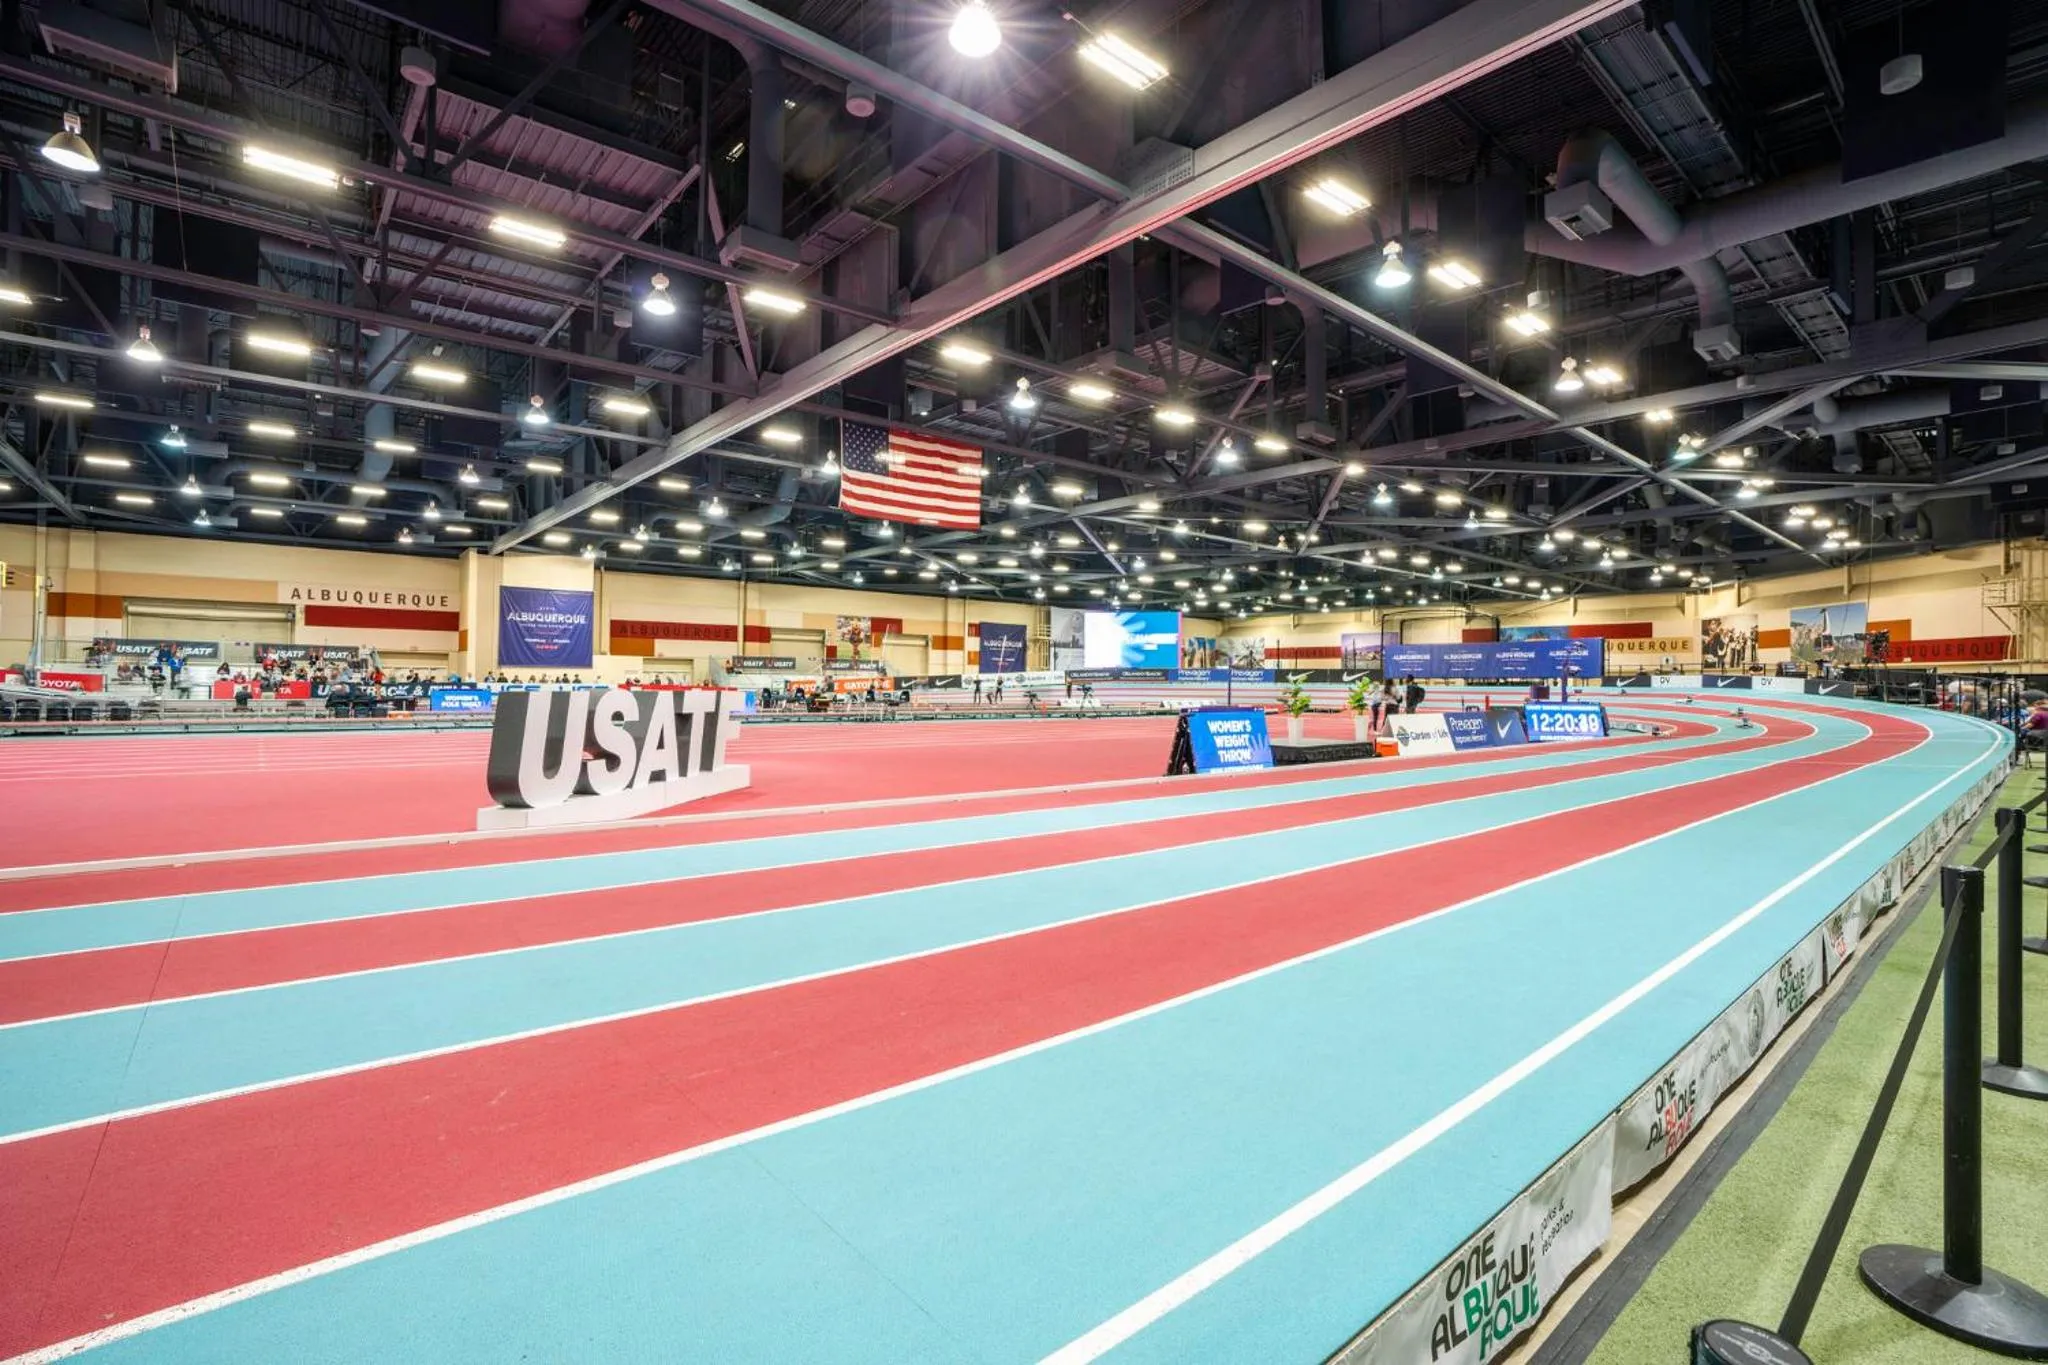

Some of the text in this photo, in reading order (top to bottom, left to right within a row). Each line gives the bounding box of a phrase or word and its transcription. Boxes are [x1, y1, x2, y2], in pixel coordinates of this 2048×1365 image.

[291, 588, 449, 607] ALBUQUERQUE
[508, 612, 586, 624] ALBUQUERQUE
[619, 626, 732, 638] ALBUQUERQUE
[116, 645, 155, 654] USATF
[323, 651, 349, 659] USAT
[40, 679, 81, 688] OYOTA
[413, 684, 424, 697] &
[1207, 719, 1252, 734] WOMEN'S
[1449, 717, 1484, 732] Prevagen
[1213, 733, 1250, 748] WEIGHT
[505, 690, 747, 808] USATF
[1218, 748, 1252, 763] THROW
[1446, 1231, 1496, 1302] ONE
